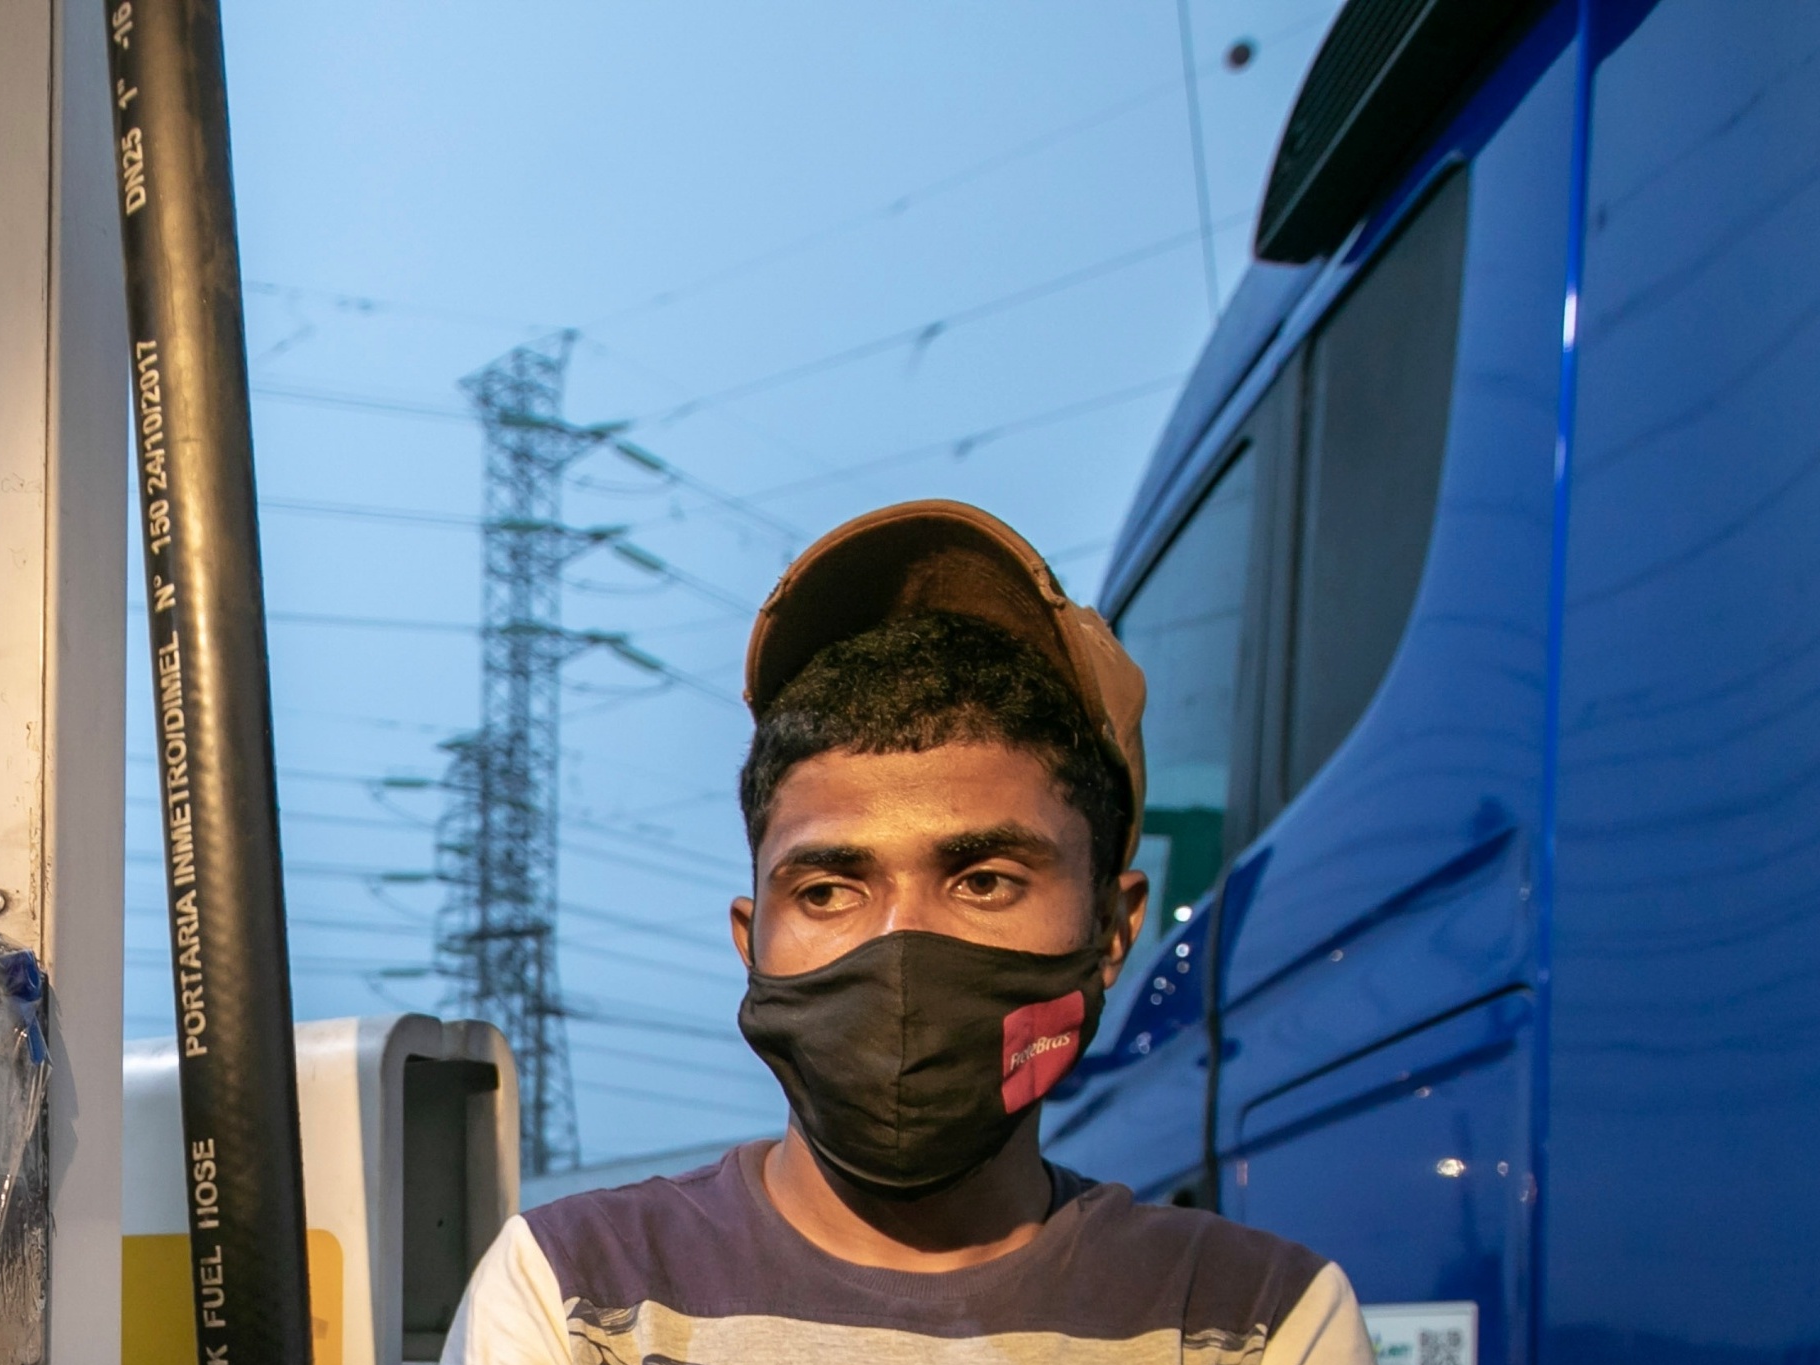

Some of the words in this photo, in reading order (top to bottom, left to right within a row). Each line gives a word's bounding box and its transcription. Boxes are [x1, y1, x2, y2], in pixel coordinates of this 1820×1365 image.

[121, 126, 147, 216] DN25
[136, 339, 168, 494] 24/10/2017
[148, 499, 172, 555] 150
[174, 888, 208, 1058] PORTARIA
[192, 1137, 217, 1229] HOSE
[201, 1244, 227, 1328] FUEL
